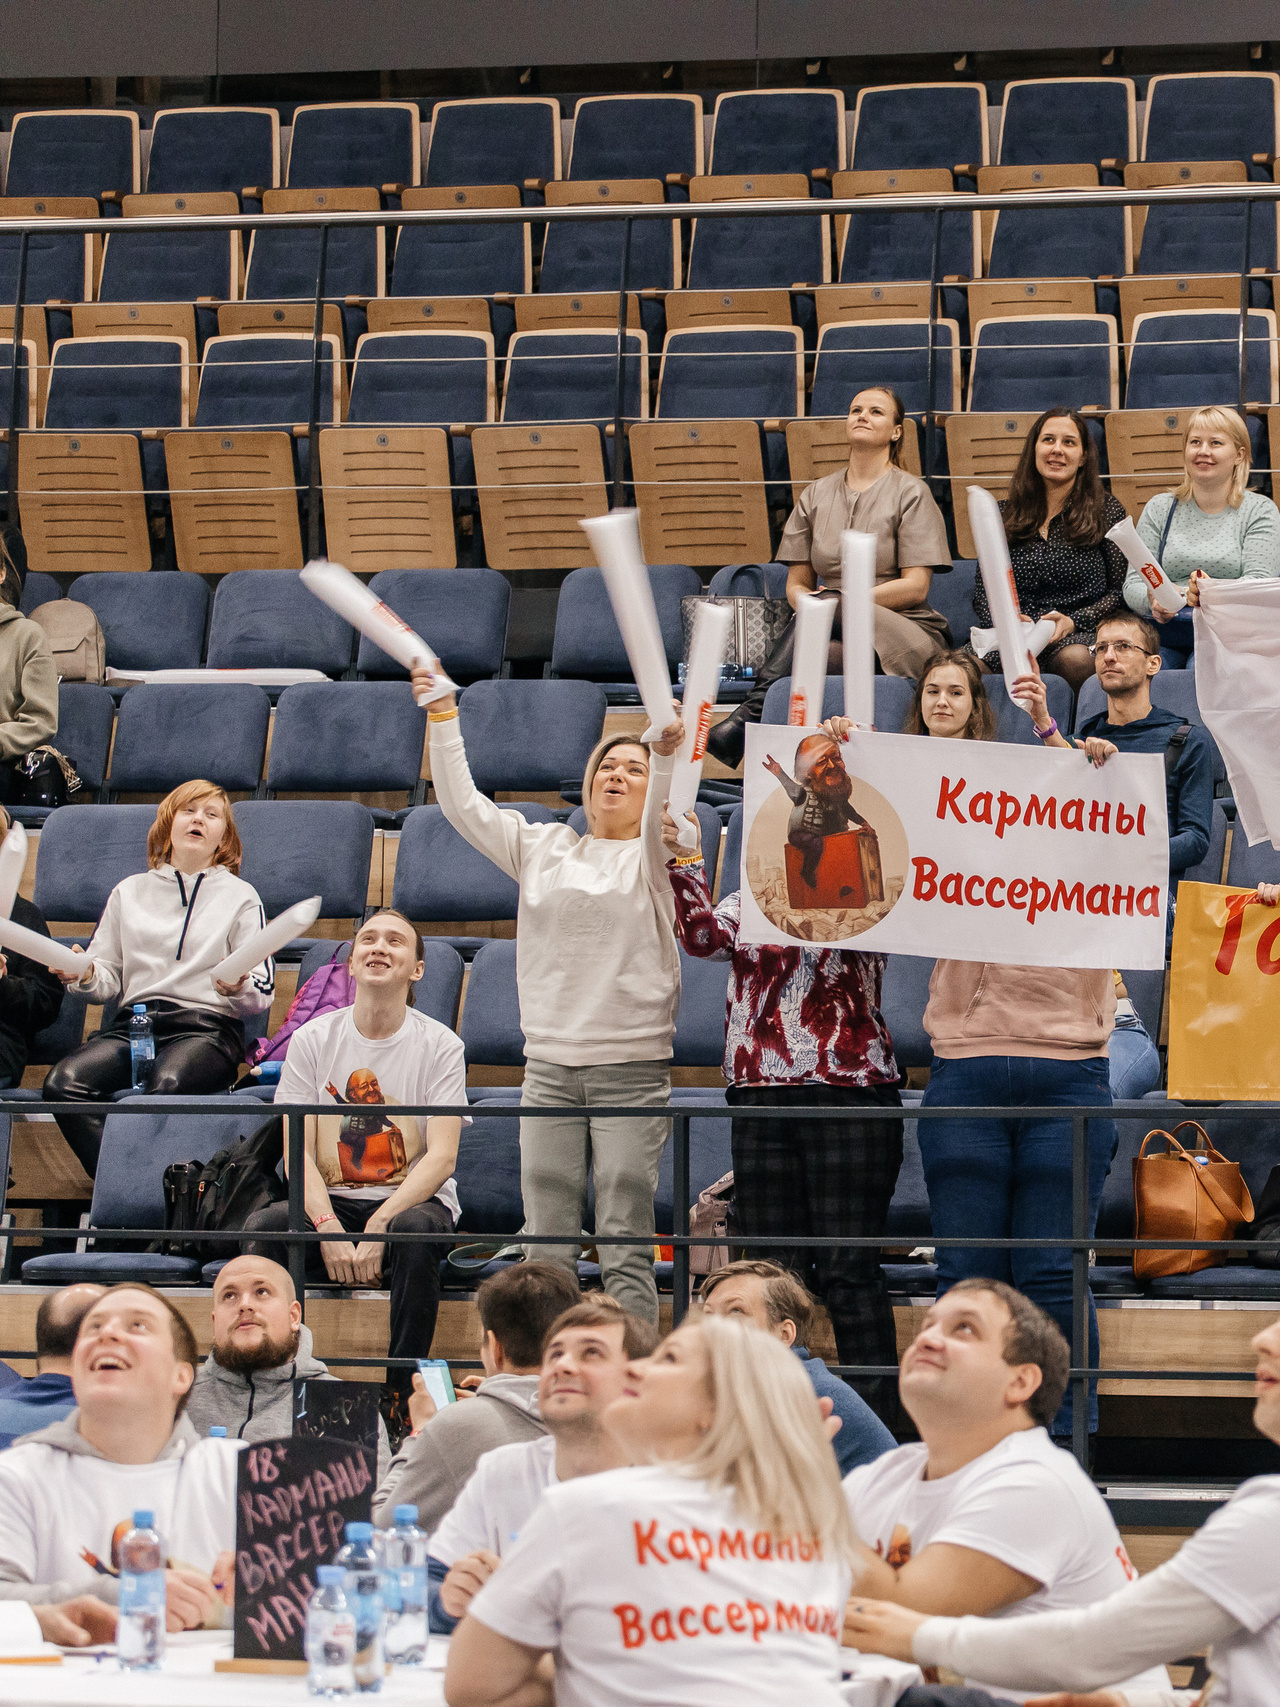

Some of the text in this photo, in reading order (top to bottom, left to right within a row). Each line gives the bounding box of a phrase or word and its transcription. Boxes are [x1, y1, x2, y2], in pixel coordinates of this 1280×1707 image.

[936, 776, 1146, 839] Карманы
[911, 856, 1160, 925] Вассермана
[240, 1447, 373, 1534] КАРМАНЫ
[238, 1510, 345, 1595] ВАССЕР
